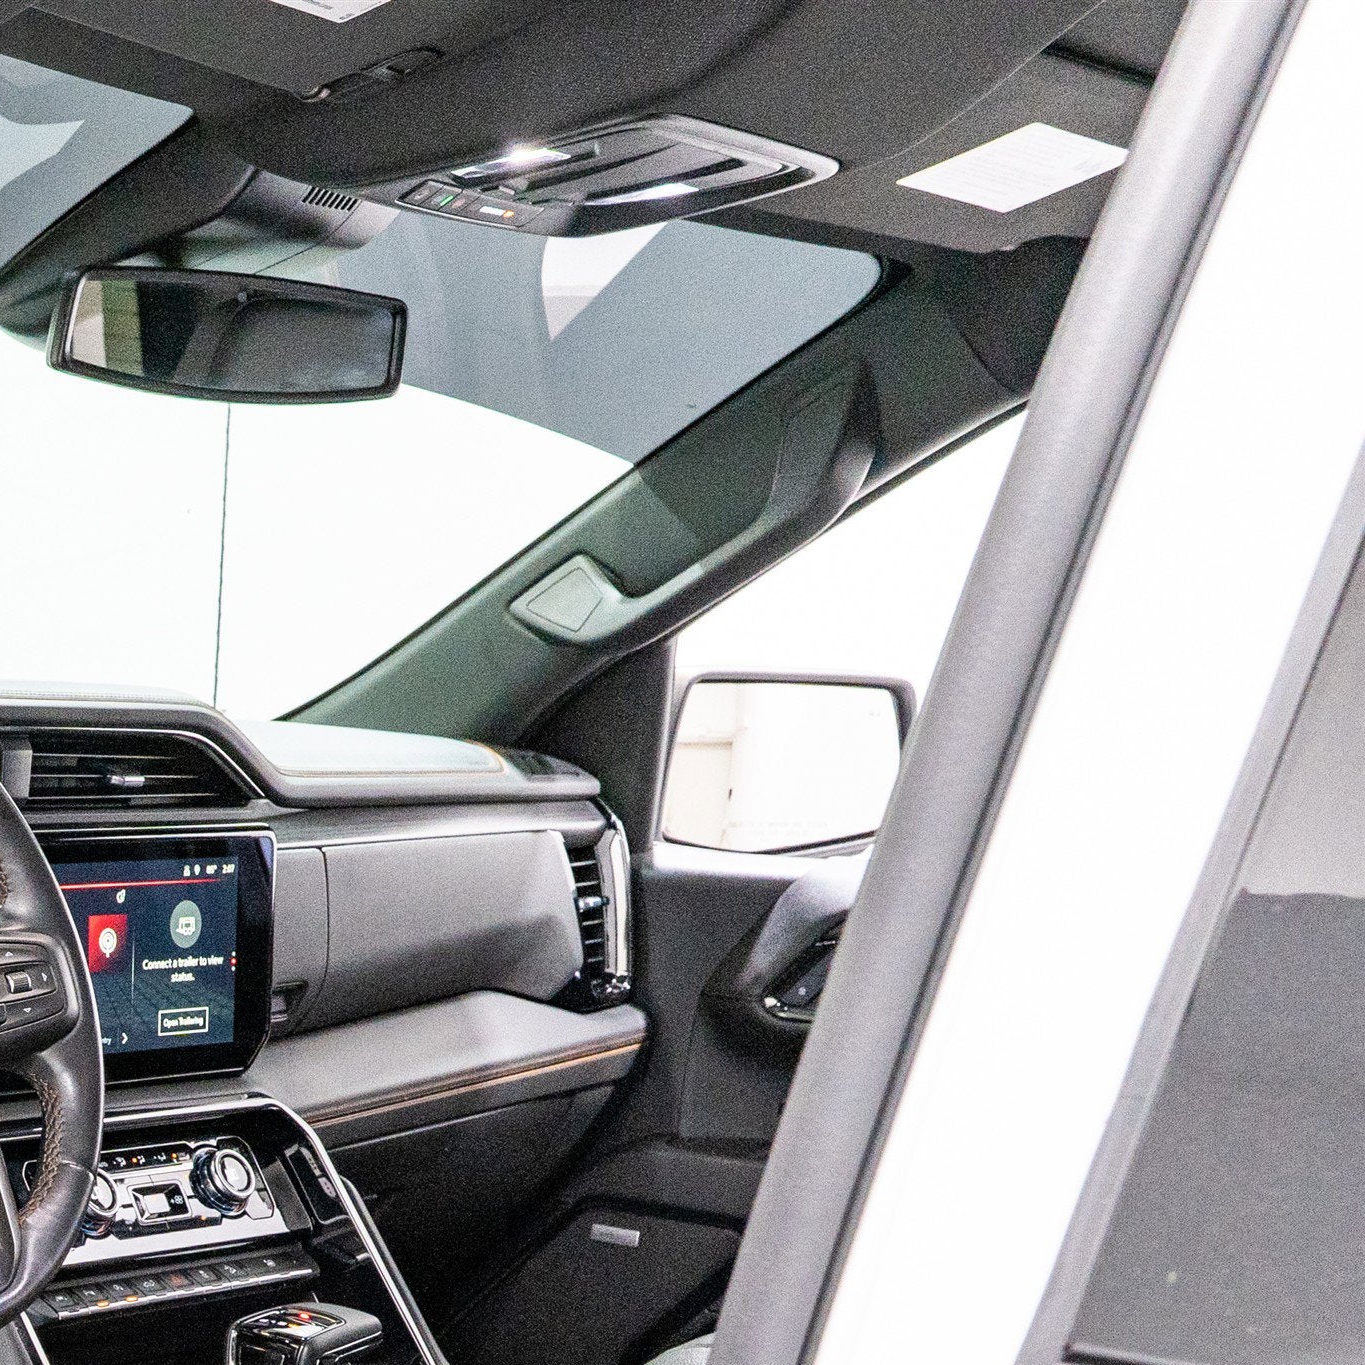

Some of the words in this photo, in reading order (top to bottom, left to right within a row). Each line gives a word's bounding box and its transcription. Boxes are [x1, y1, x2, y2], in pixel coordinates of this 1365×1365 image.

[142, 959, 173, 970] Connect
[178, 956, 199, 968] trailer
[199, 956, 207, 966] to
[207, 955, 224, 966] view
[162, 1018, 178, 1028] Open
